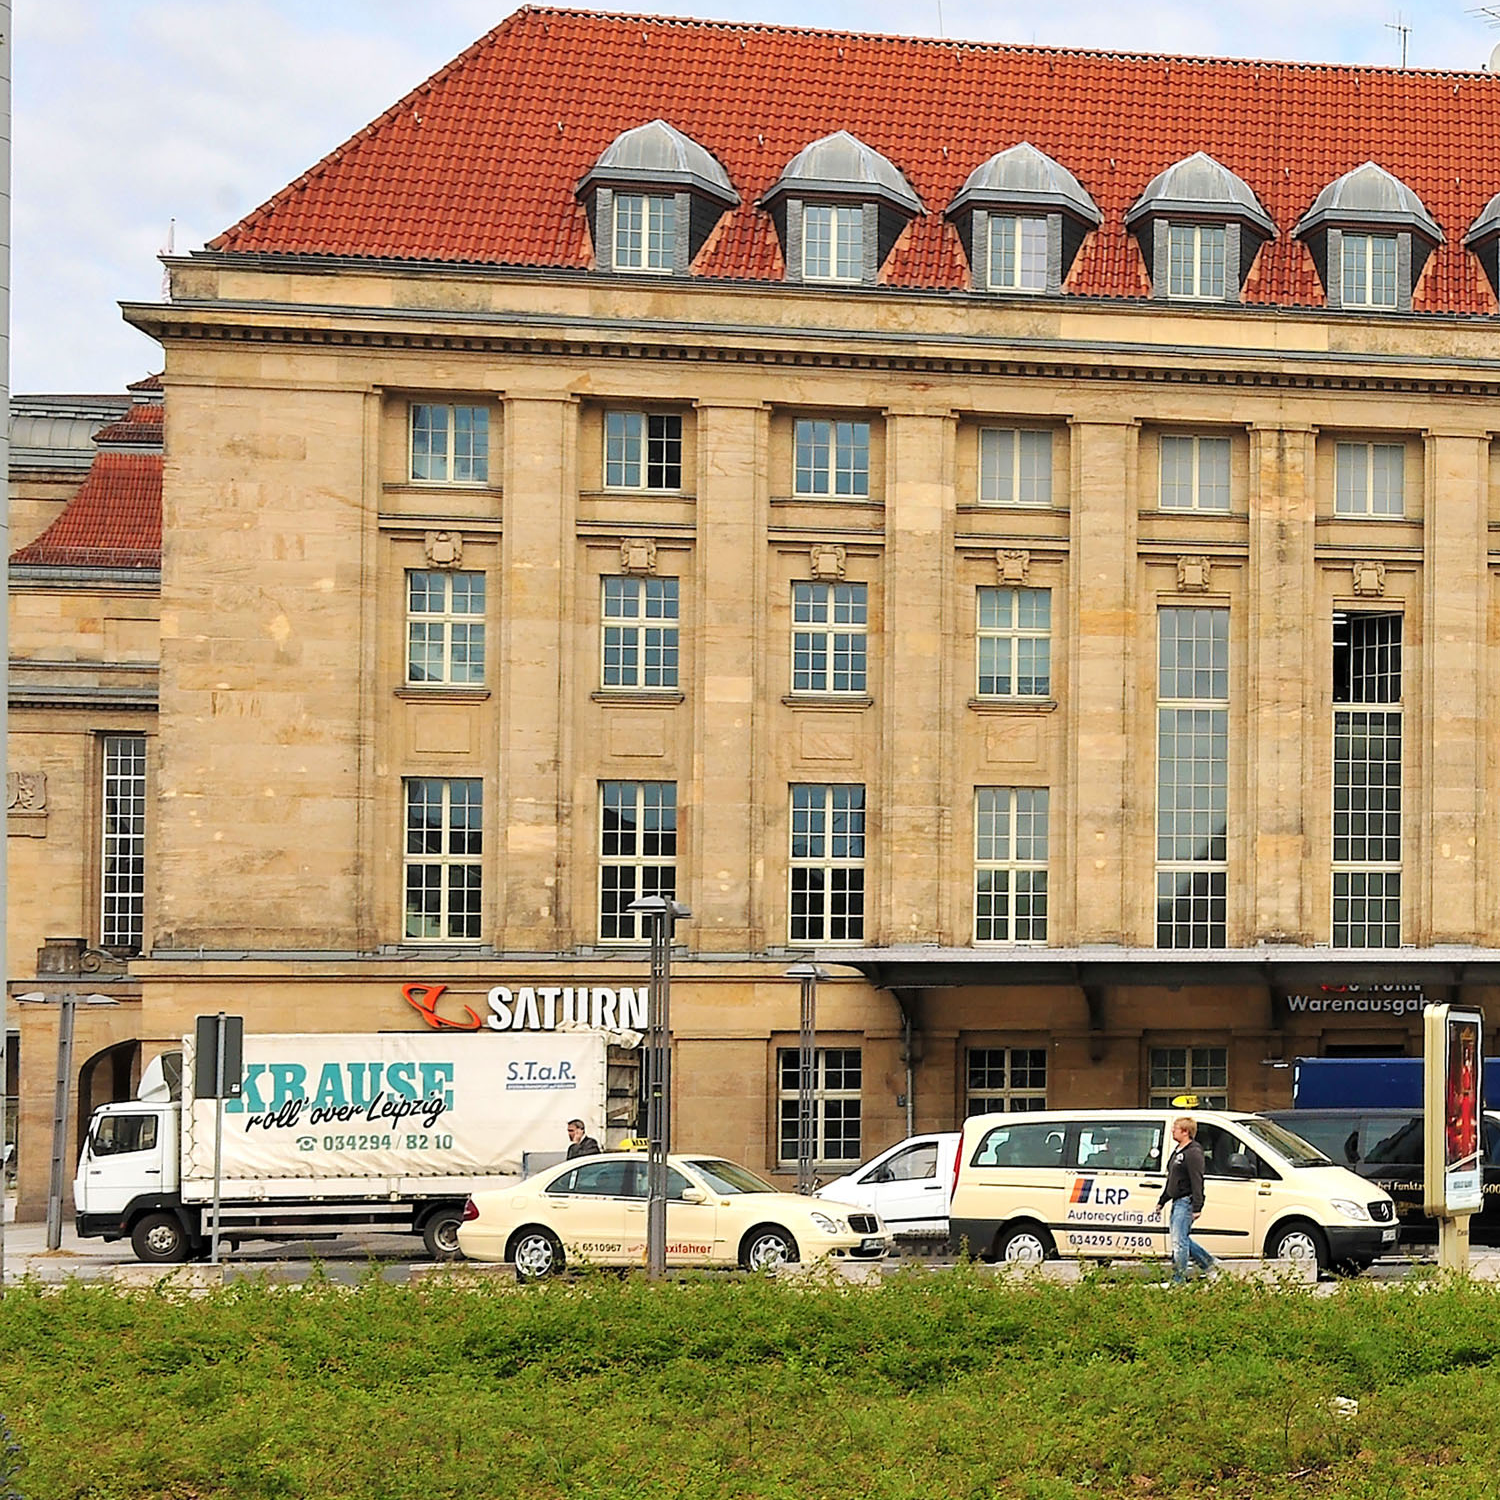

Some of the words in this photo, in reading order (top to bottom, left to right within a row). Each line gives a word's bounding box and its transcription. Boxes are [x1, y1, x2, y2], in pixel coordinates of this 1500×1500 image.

[486, 986, 648, 1030] SATURN
[507, 1061, 576, 1081] S.T.a.R.
[225, 1062, 454, 1113] KRAUSE
[310, 1104, 364, 1125] over
[366, 1091, 448, 1130] Leipzig
[323, 1134, 392, 1151] 034294
[406, 1134, 429, 1150] 82
[435, 1134, 453, 1150] 10
[1393, 1181, 1425, 1191] Funkta
[1095, 1188, 1130, 1205] LRP
[1068, 1209, 1162, 1224] Autorecycling.de
[582, 1242, 622, 1252] 6510967
[665, 1243, 712, 1254] axifahrer
[1069, 1234, 1113, 1246] 034295
[1124, 1236, 1152, 1247] 7580
